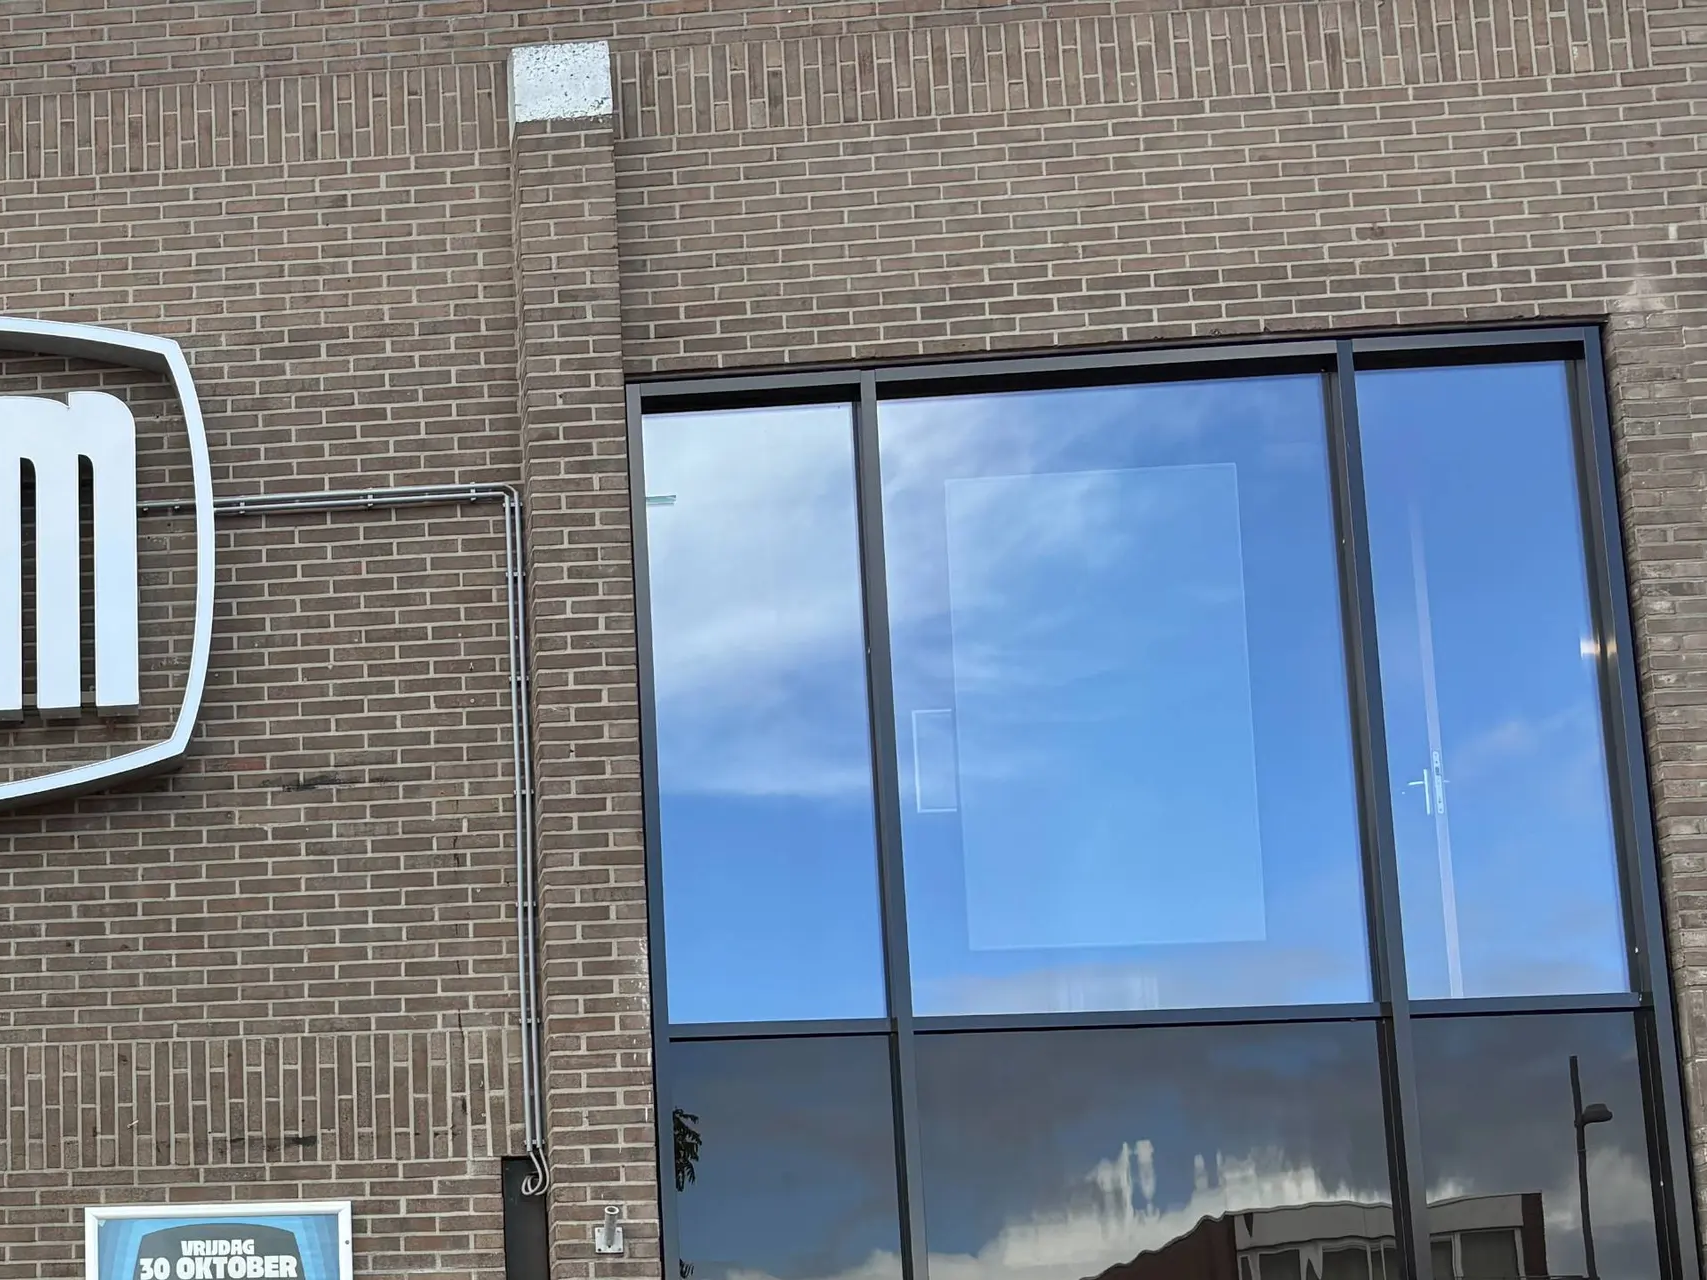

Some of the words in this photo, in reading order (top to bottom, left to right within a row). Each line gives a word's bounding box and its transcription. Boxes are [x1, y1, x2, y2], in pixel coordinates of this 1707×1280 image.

[181, 1239, 255, 1256] VRIJDAG
[140, 1257, 171, 1280] 30
[176, 1255, 298, 1280] OKTOBER
